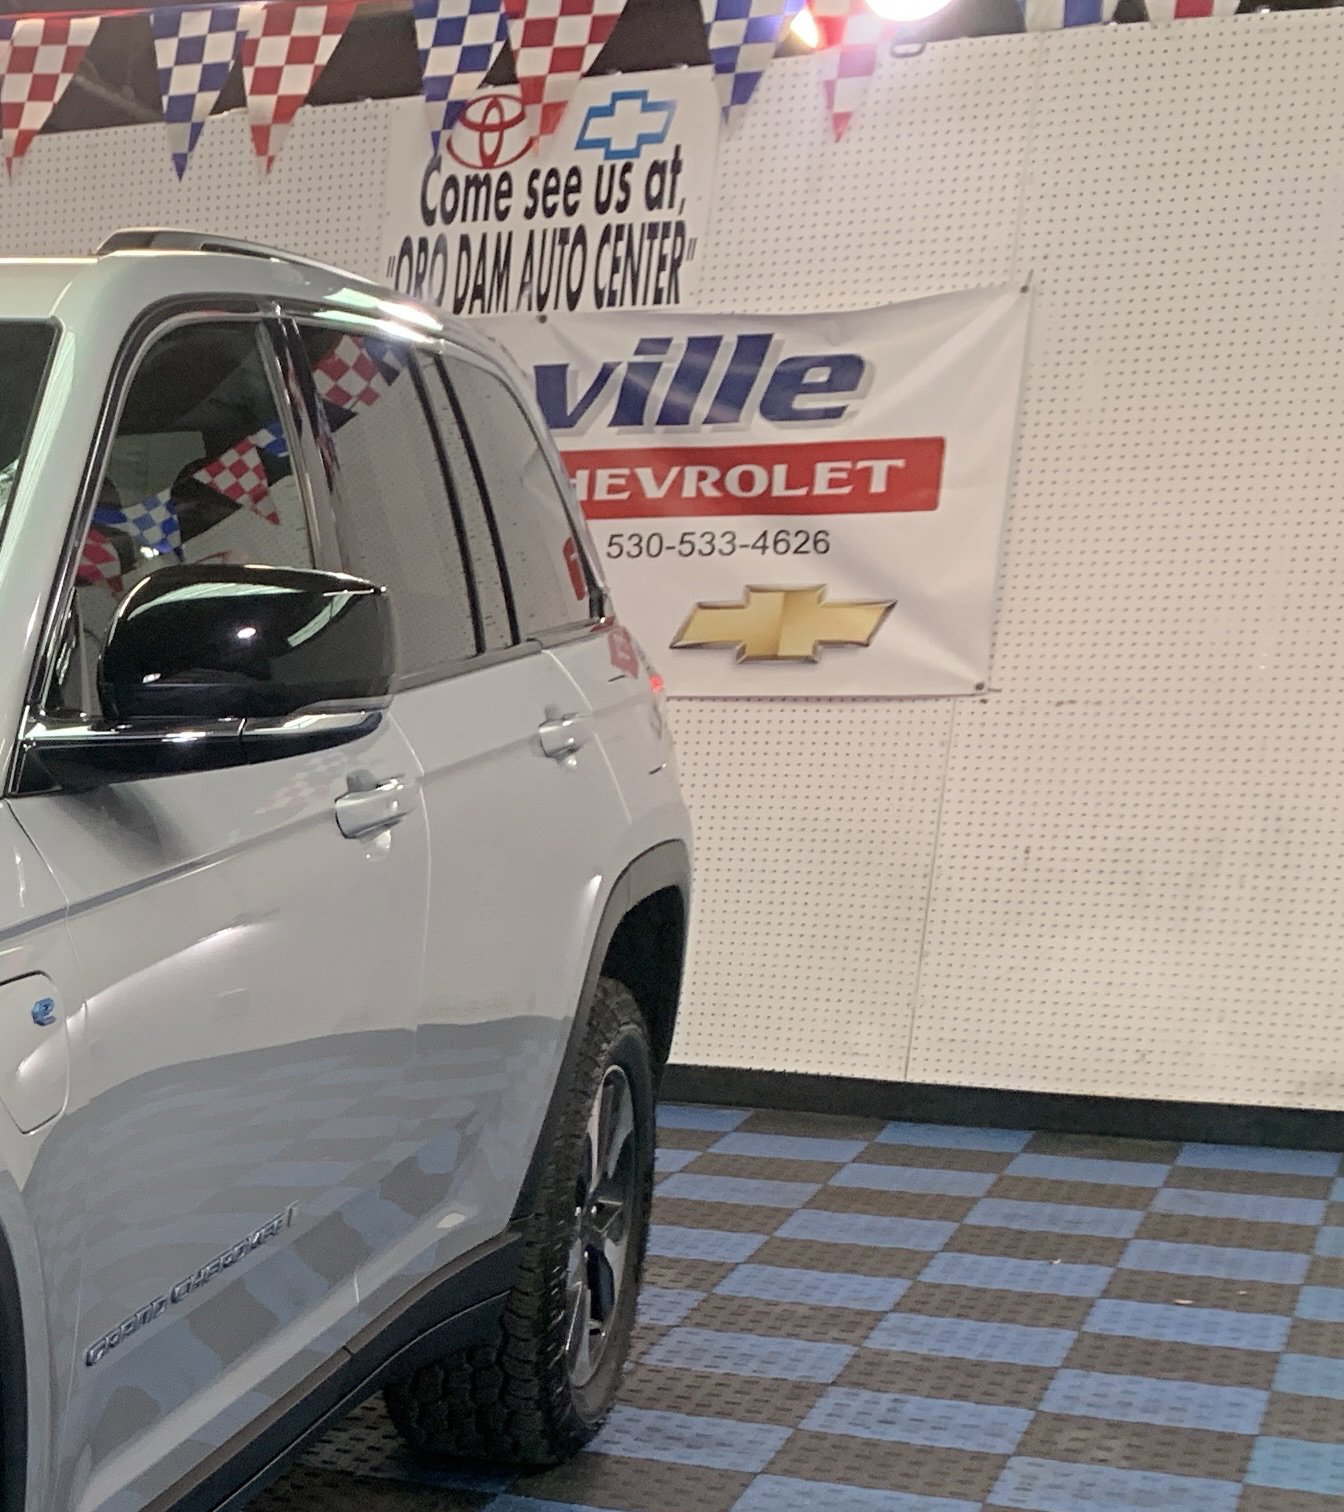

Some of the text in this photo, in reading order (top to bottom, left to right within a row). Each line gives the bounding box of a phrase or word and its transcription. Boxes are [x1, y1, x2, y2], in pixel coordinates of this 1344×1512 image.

[421, 144, 687, 227] Come see us at,
[452, 230, 515, 316] DAM
[515, 223, 588, 313] AUTO
[593, 220, 699, 311] CENTER"
[533, 332, 871, 434] ville
[568, 458, 906, 502] HEVROLET
[606, 529, 832, 561] 530-533-4626
